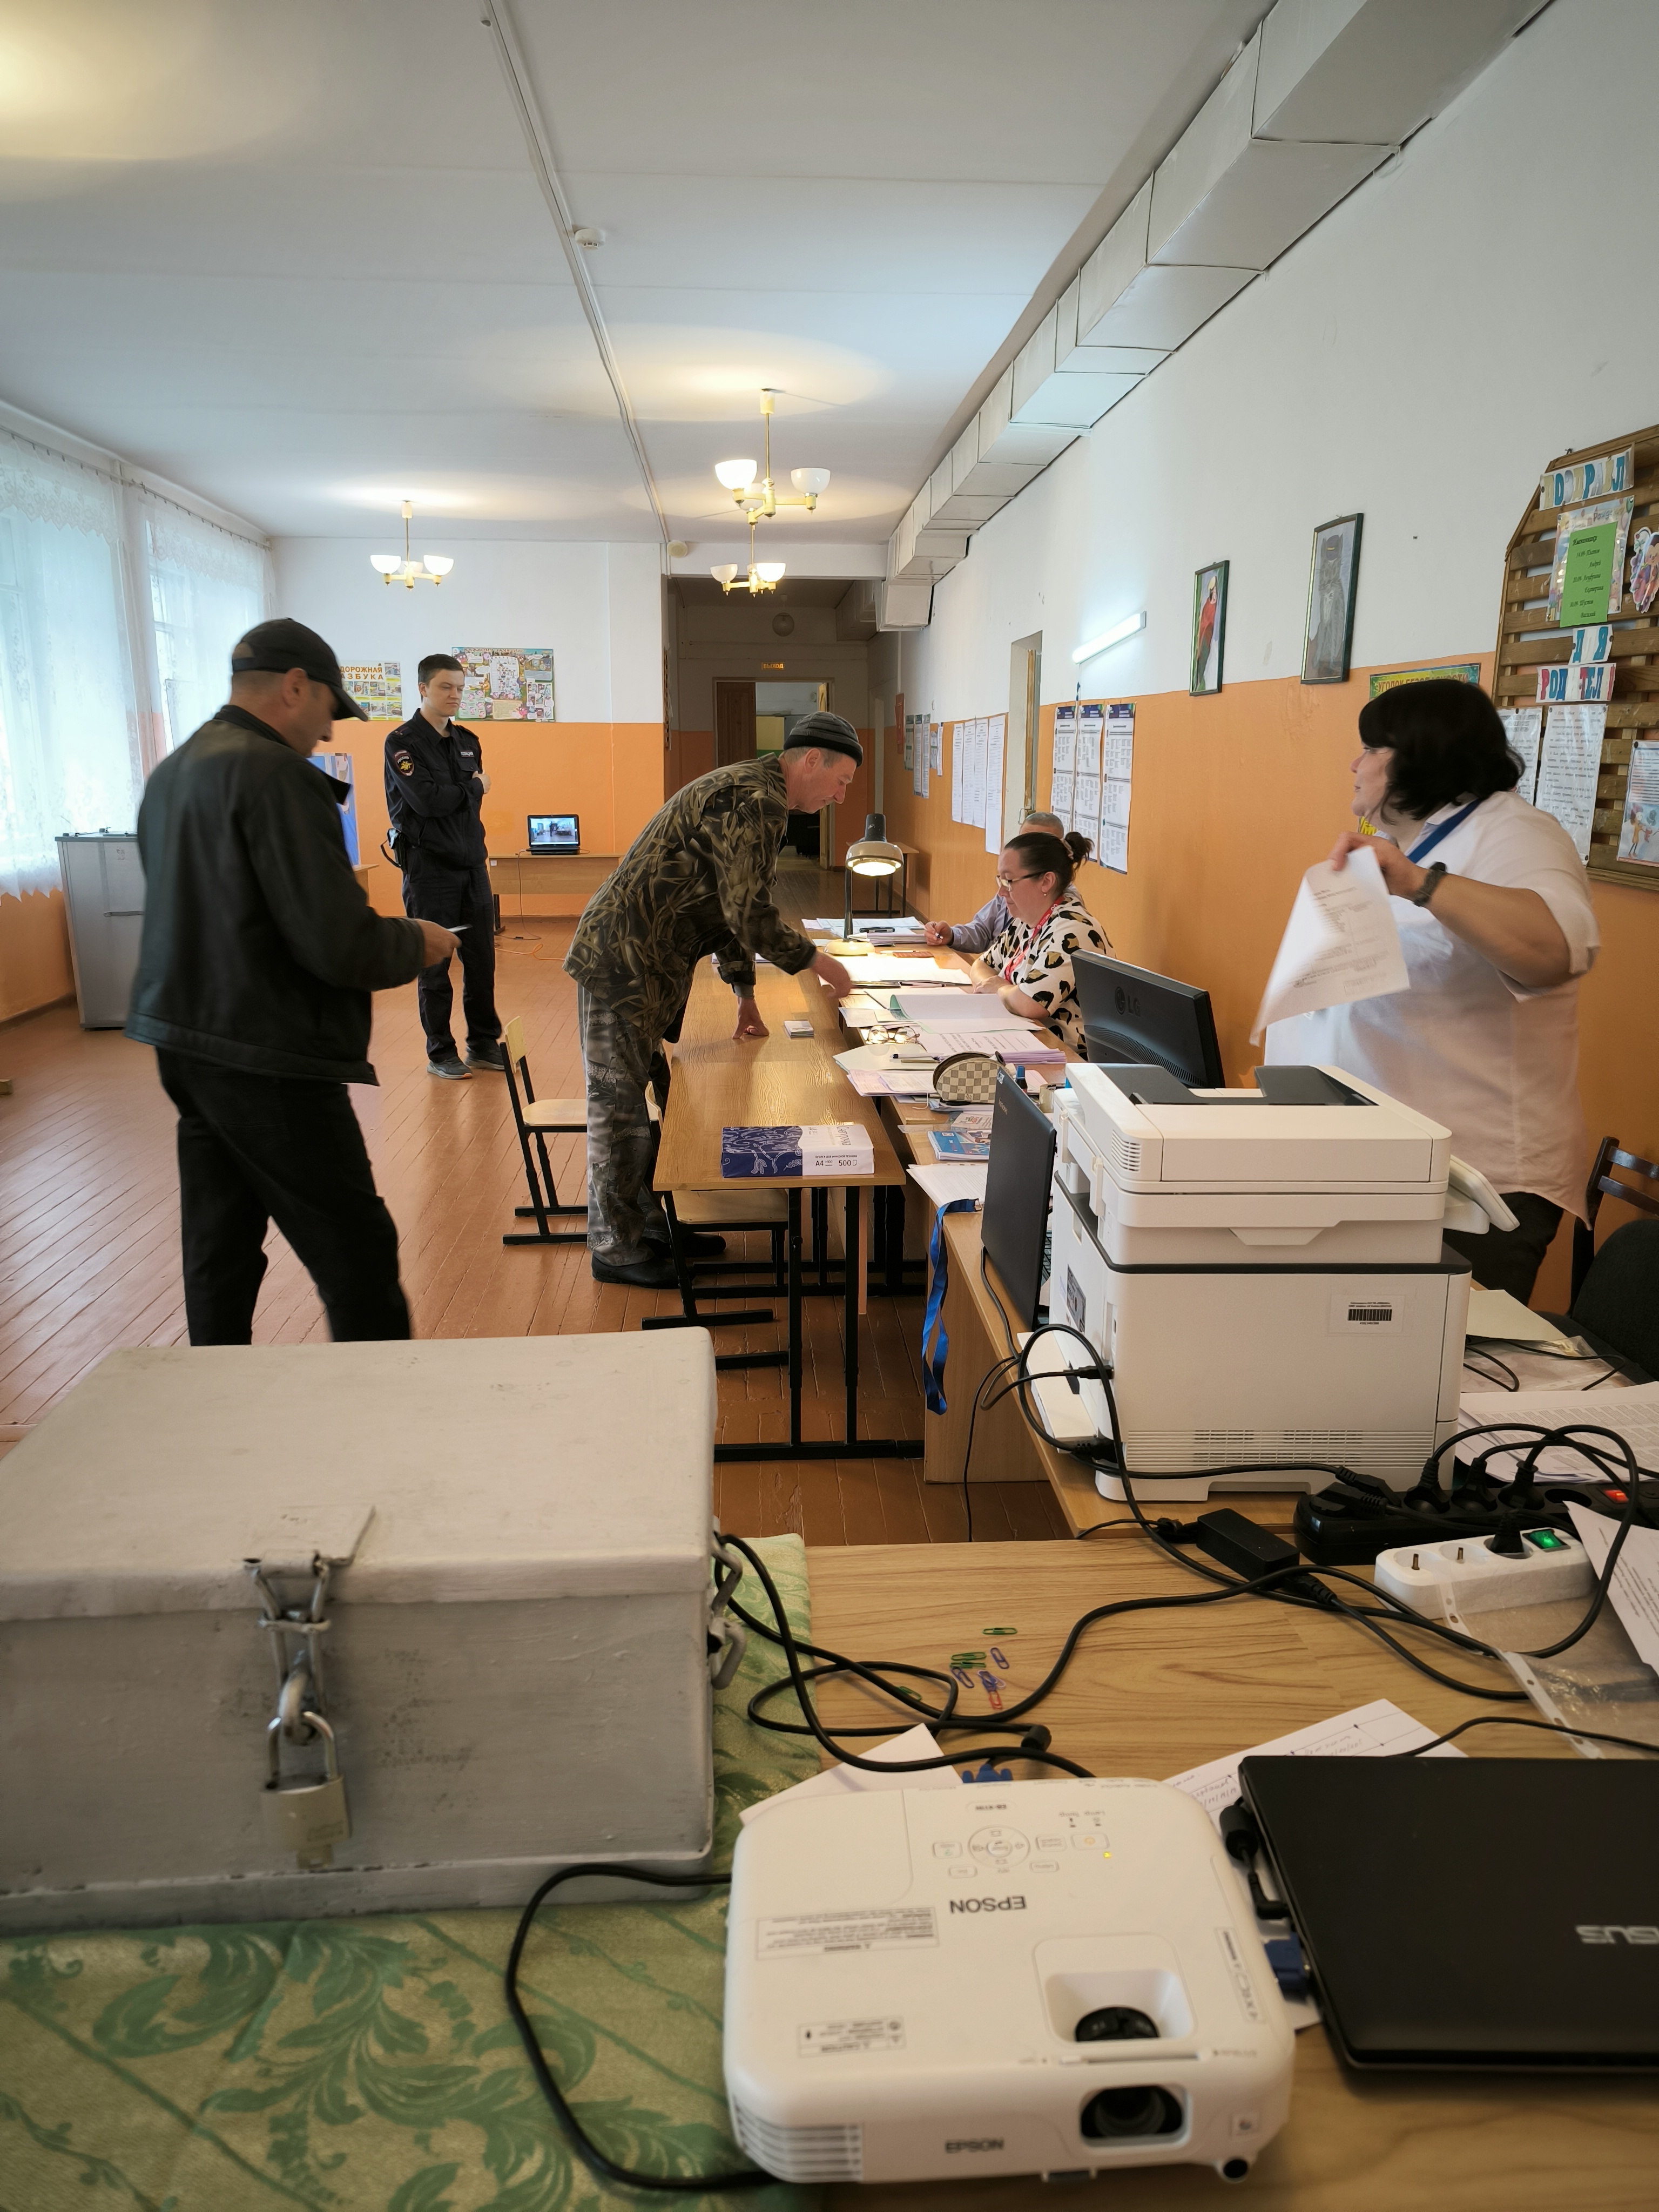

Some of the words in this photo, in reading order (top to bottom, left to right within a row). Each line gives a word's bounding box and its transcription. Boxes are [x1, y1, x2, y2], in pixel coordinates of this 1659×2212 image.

[1572, 626, 1609, 663] ДЛЯ
[1128, 995, 1141, 1017] LG
[949, 1896, 1026, 1914] EPSON
[945, 2137, 1004, 2154] EPSON
